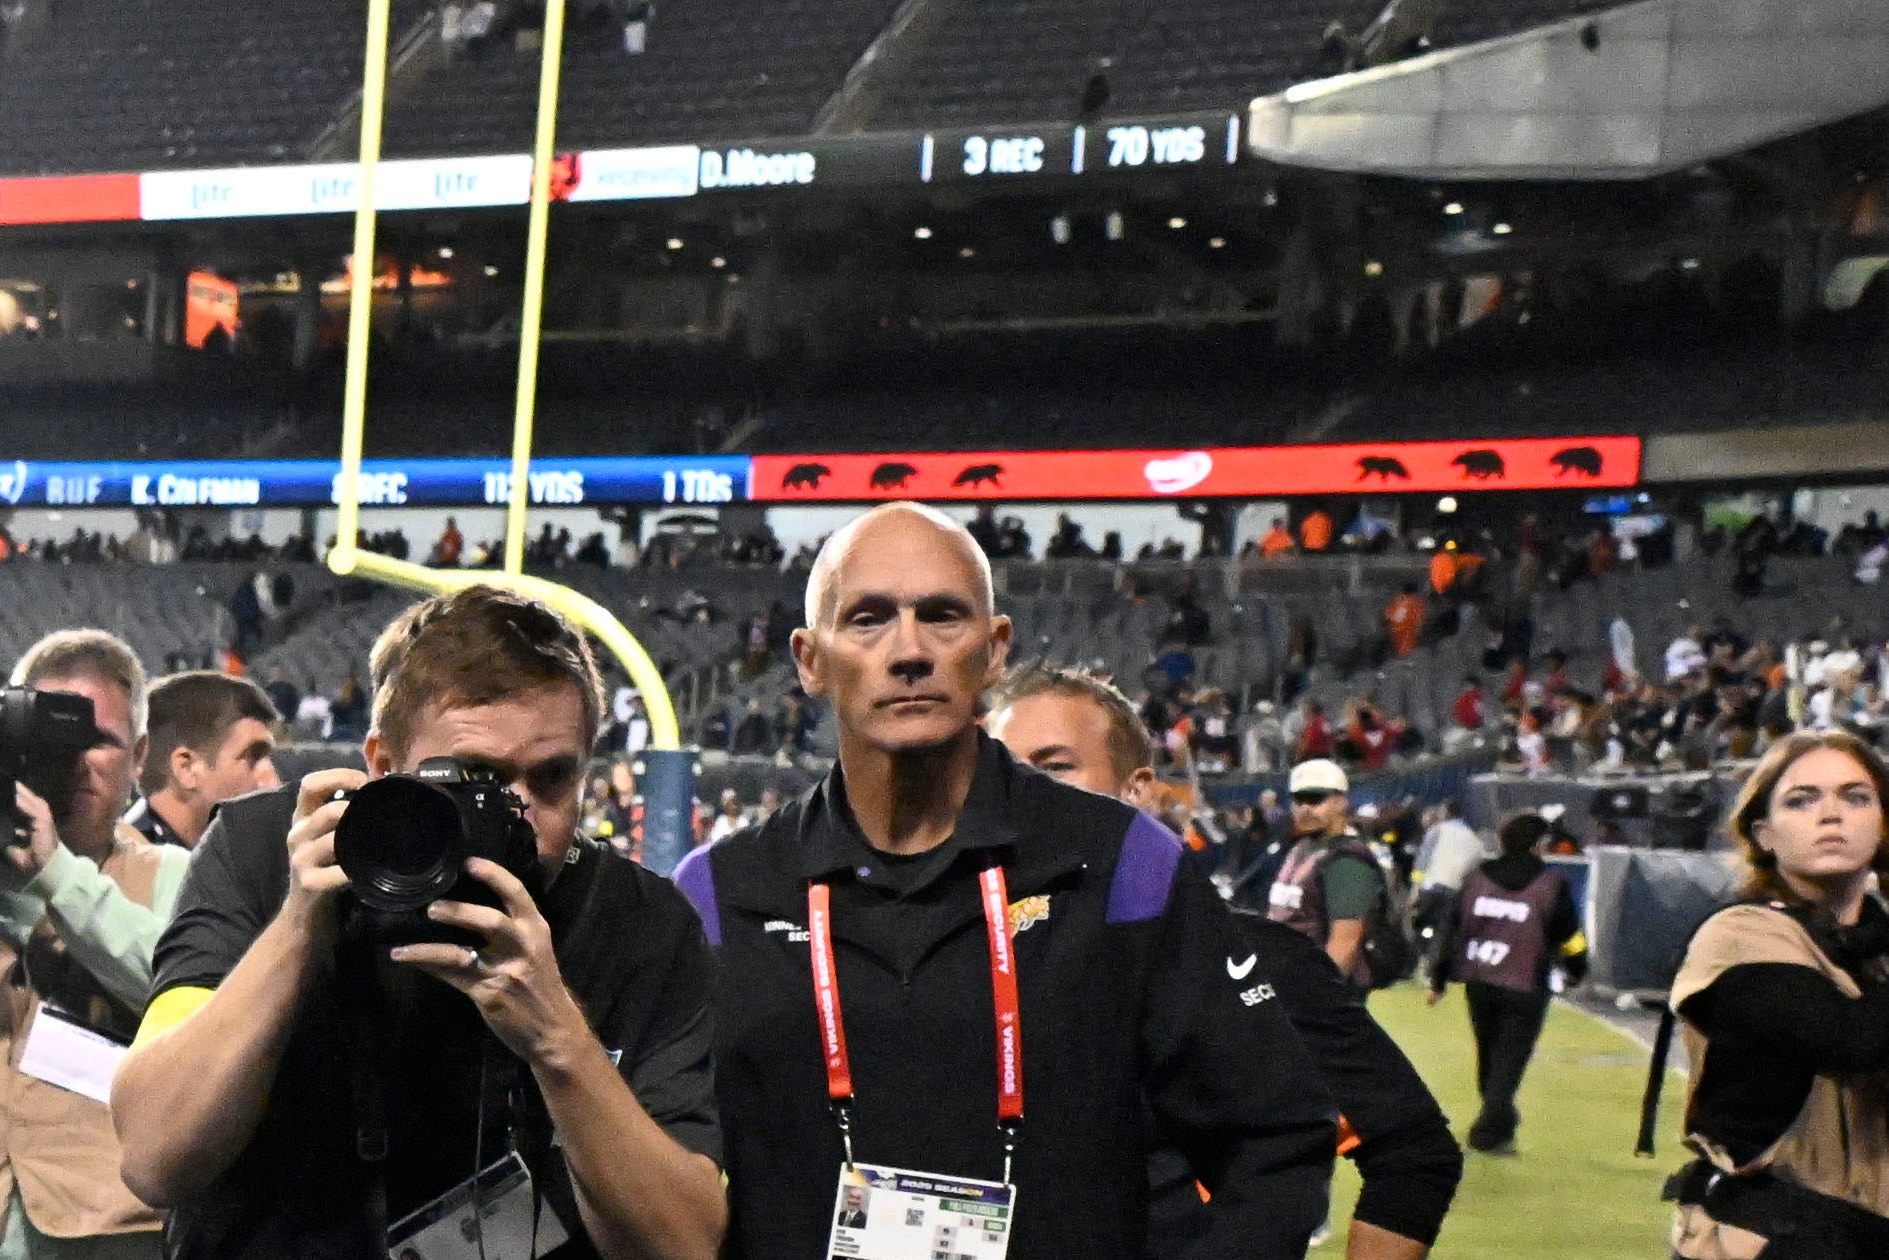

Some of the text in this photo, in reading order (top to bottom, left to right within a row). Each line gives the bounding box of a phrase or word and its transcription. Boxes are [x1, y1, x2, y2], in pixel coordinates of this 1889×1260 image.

[963, 137, 1045, 175] 3 REC
[1108, 126, 1206, 165] 70 YDS
[529, 472, 583, 502] YDS
[420, 769, 451, 778] SONY
[1002, 1024, 1016, 1095] VIKINGS
